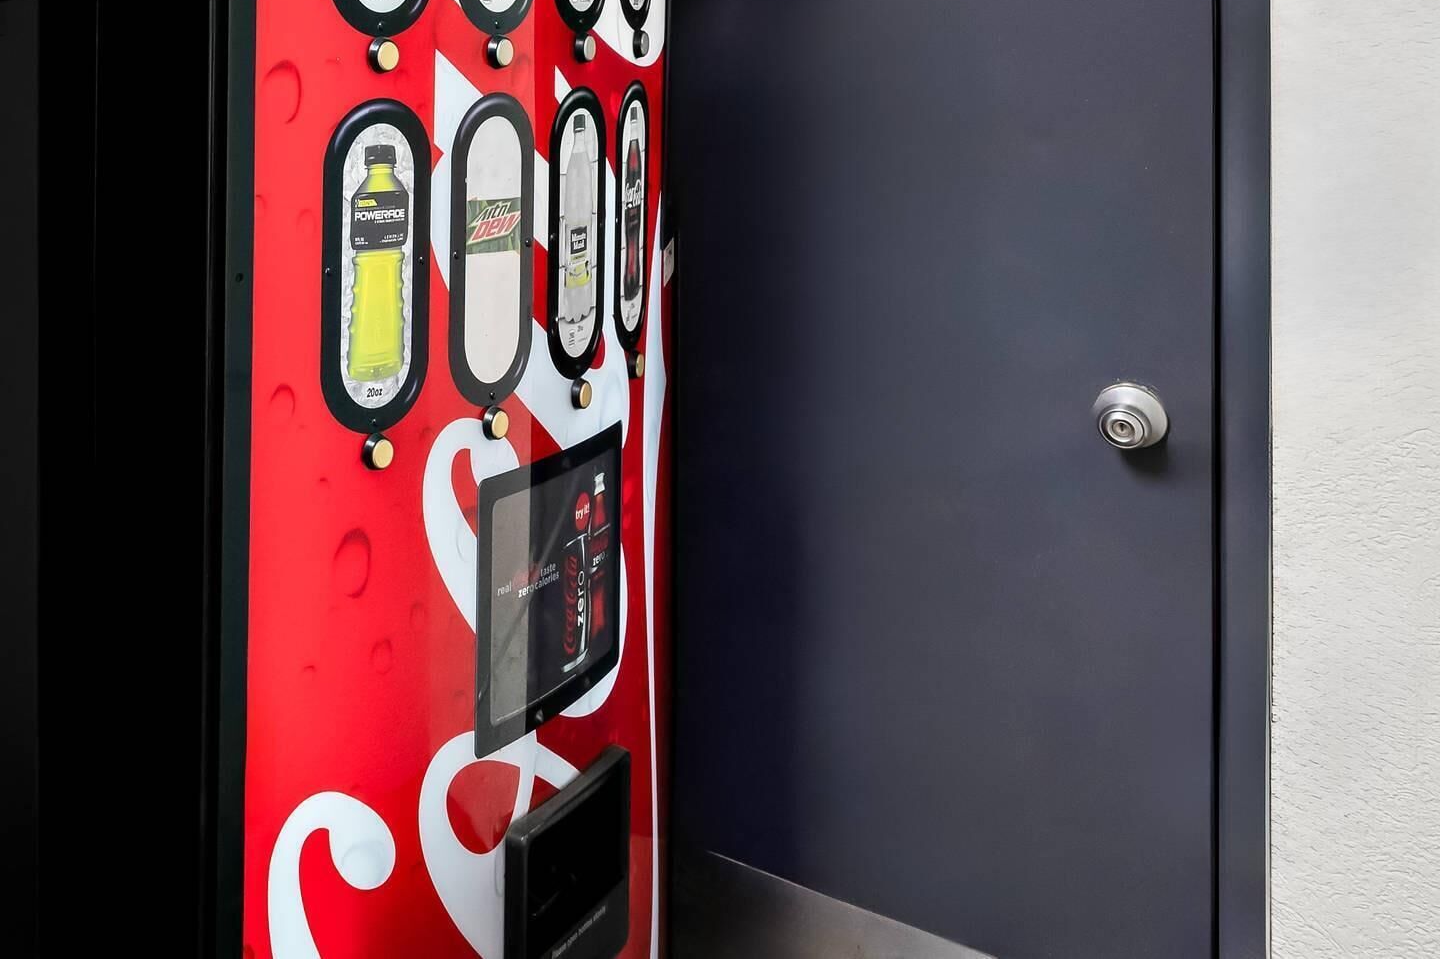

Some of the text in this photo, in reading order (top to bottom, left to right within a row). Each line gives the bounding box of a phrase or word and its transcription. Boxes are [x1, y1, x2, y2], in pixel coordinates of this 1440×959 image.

[354, 209, 405, 221] POWERADE
[497, 580, 512, 597] real
[518, 580, 534, 599] zero
